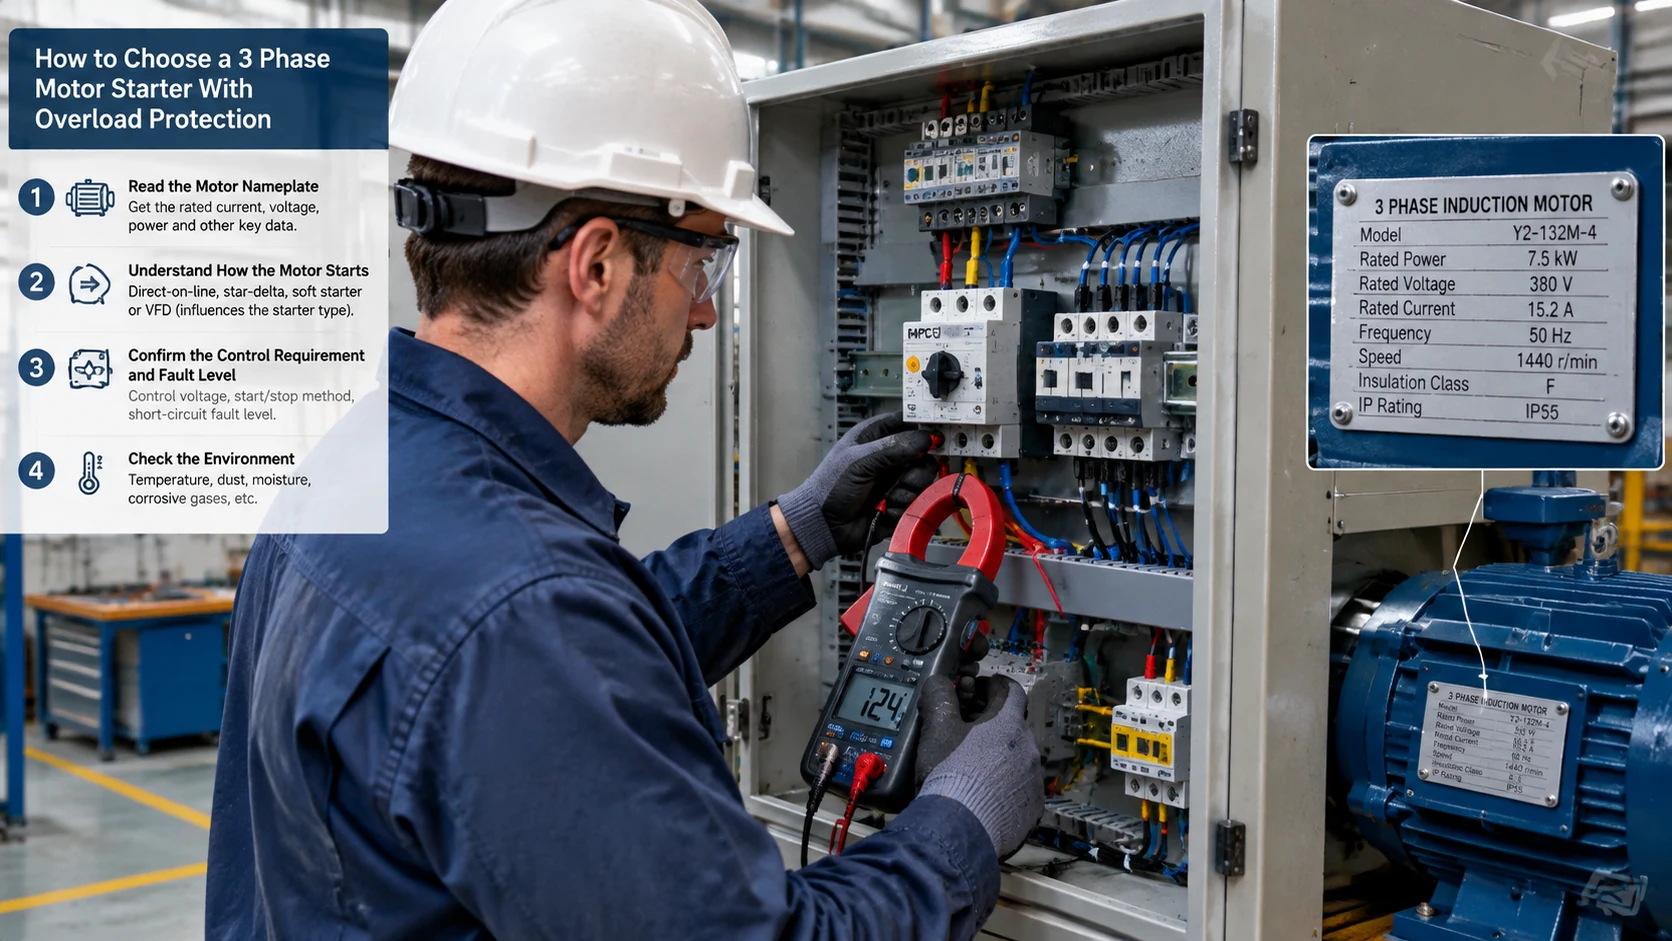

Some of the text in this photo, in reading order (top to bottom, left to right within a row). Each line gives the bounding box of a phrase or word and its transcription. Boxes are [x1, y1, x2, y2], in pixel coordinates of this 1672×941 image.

[1375, 195, 1593, 215] 3 PHASE INDUCTION MOTOR
[1360, 227, 1402, 242] Model
[1513, 225, 1597, 241] Y2-132M-4
[1360, 252, 1446, 267] Rated Power
[1528, 250, 1578, 267] 7.5 kW
[1359, 276, 1455, 294] Rated Voltage
[1530, 276, 1573, 292] 380 V
[1359, 301, 1455, 317] Rated Current
[1528, 301, 1574, 318] 15.2 A
[1359, 325, 1432, 344] Frequency
[1529, 328, 1571, 344] 50 Hz
[1359, 349, 1402, 367] Speed
[1517, 353, 1598, 369] 1440 r/min
[1359, 374, 1469, 392] Insulation Class
[1546, 378, 1555, 394] F
[1359, 397, 1422, 418] IP Rating
[1526, 404, 1559, 420] IP55
[1455, 692, 1480, 705] PHASE
[1521, 703, 1548, 716] MOTOR
